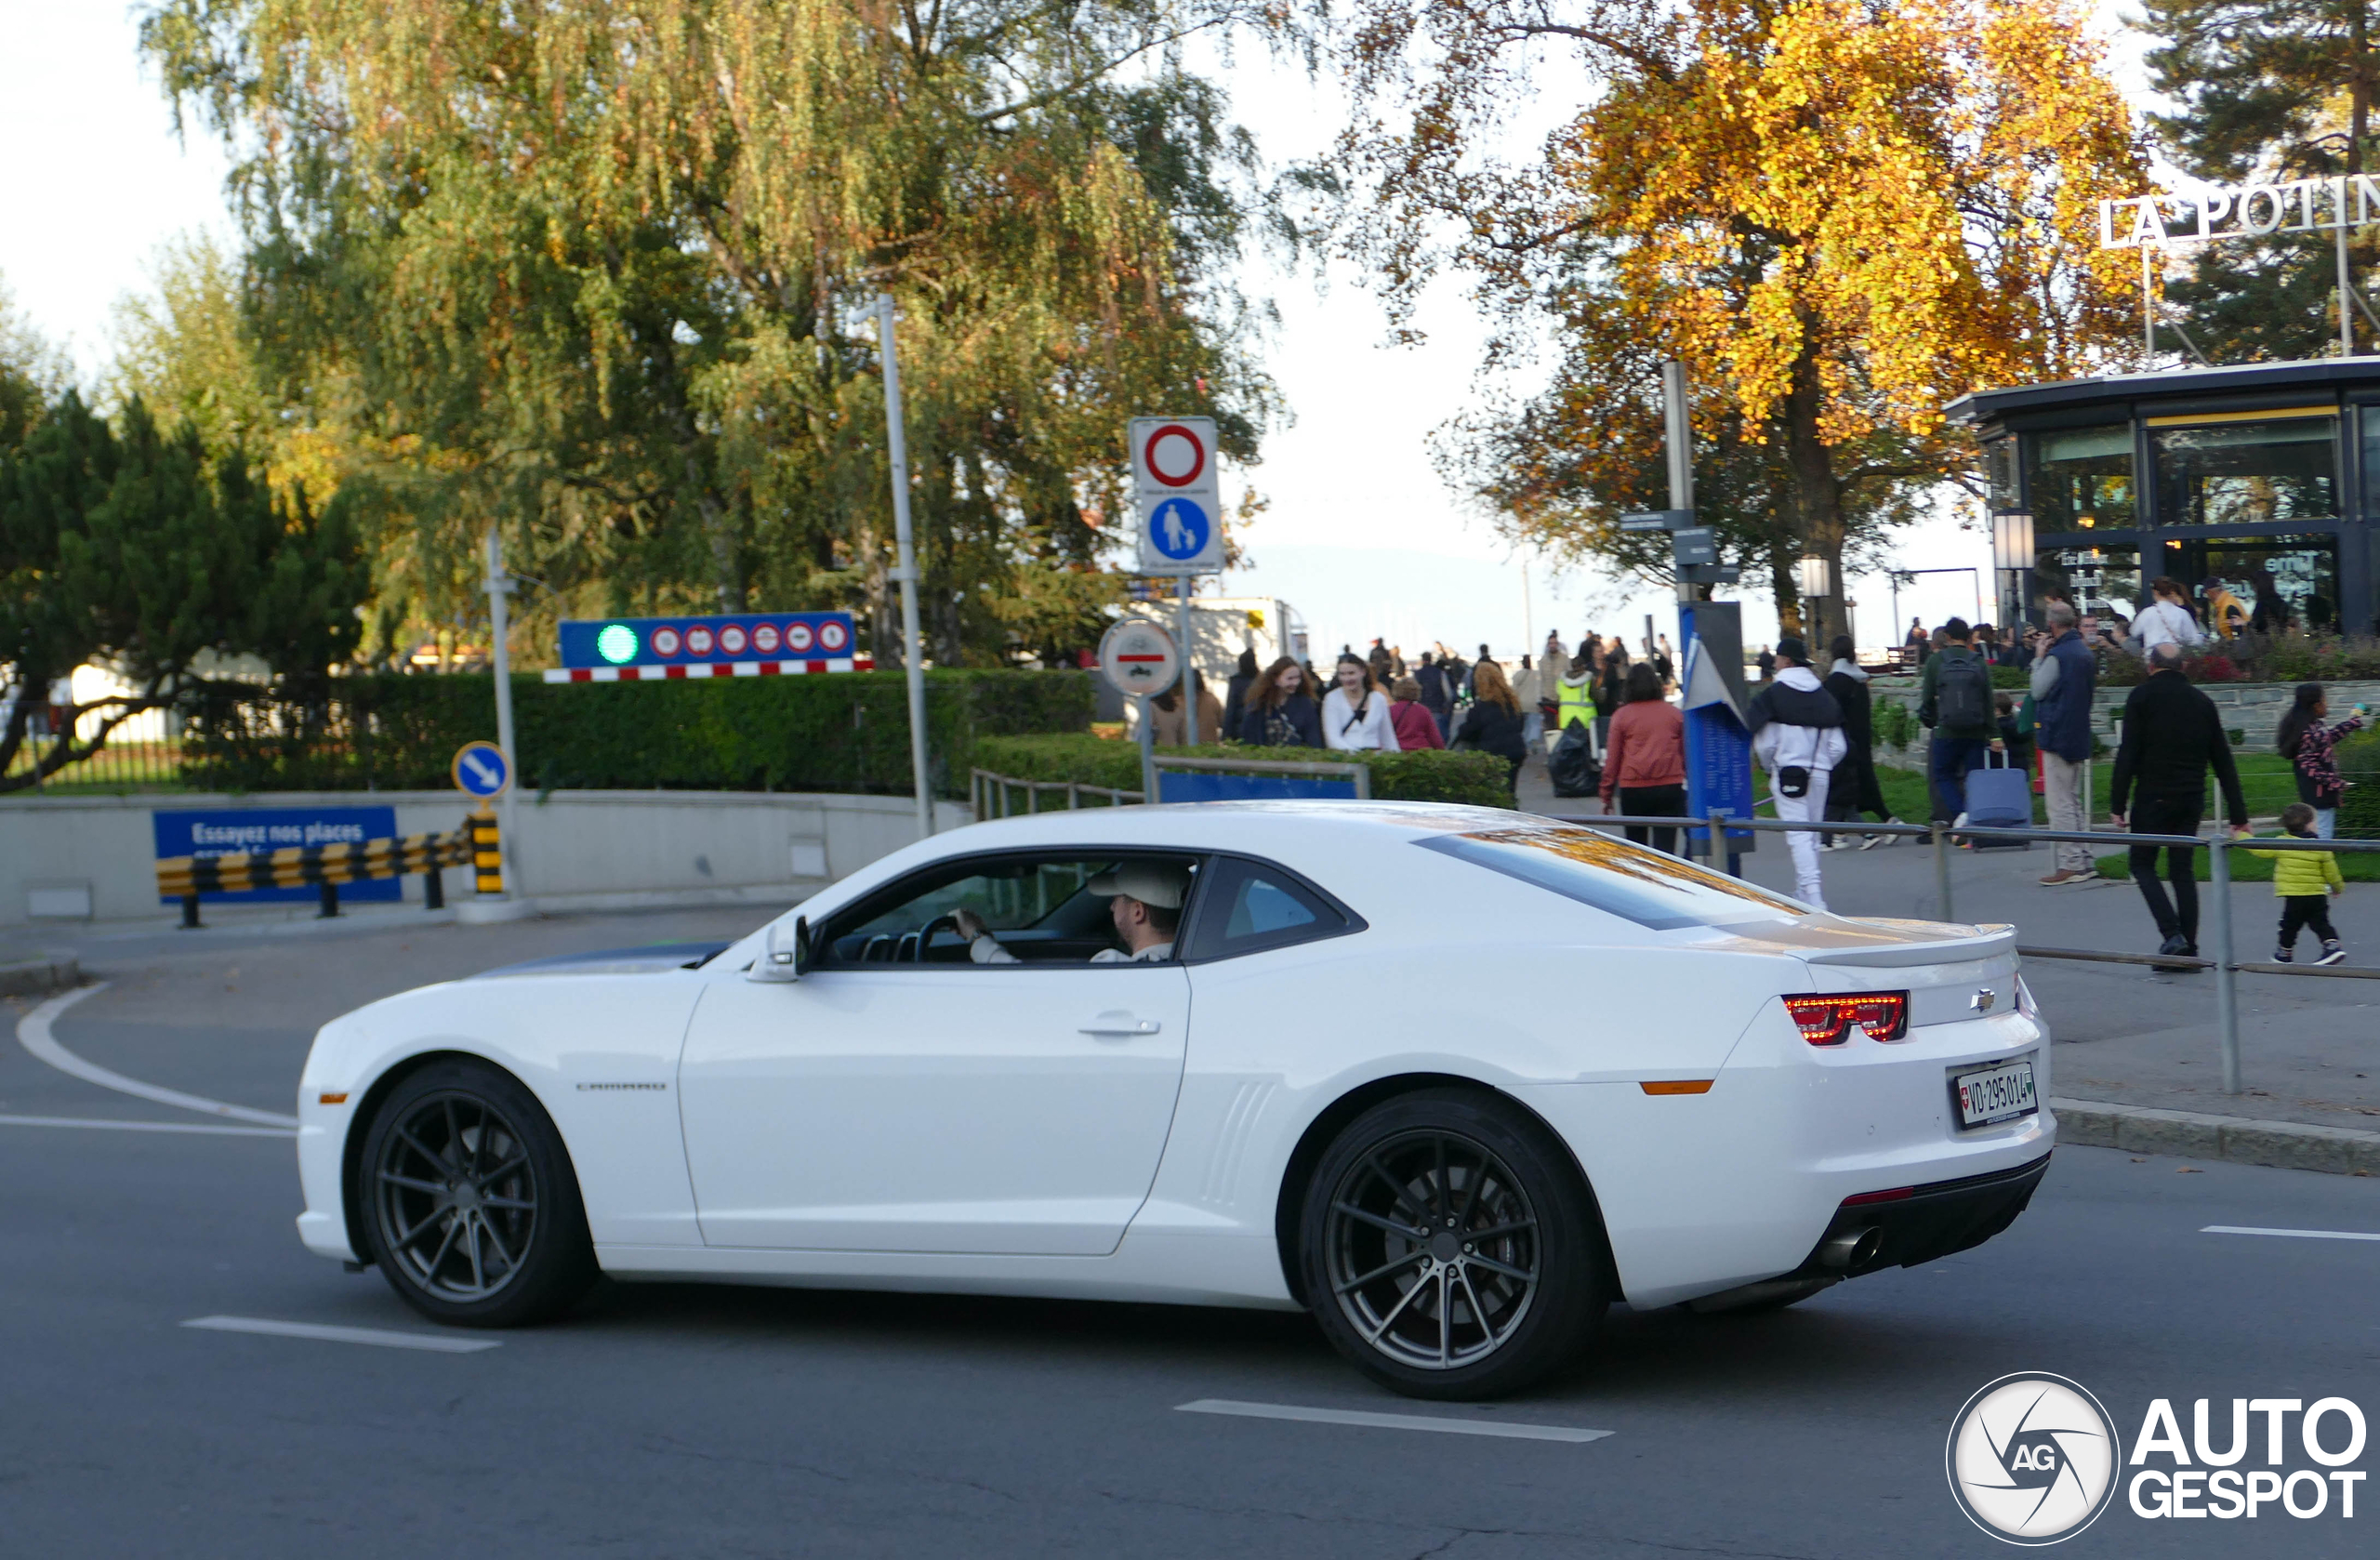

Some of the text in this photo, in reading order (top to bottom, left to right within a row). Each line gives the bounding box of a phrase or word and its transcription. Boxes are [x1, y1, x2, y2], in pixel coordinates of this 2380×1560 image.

[2098, 194, 2169, 249] LA
[192, 821, 363, 846] Essayez nos places
[575, 1082, 666, 1091] CAMARO
